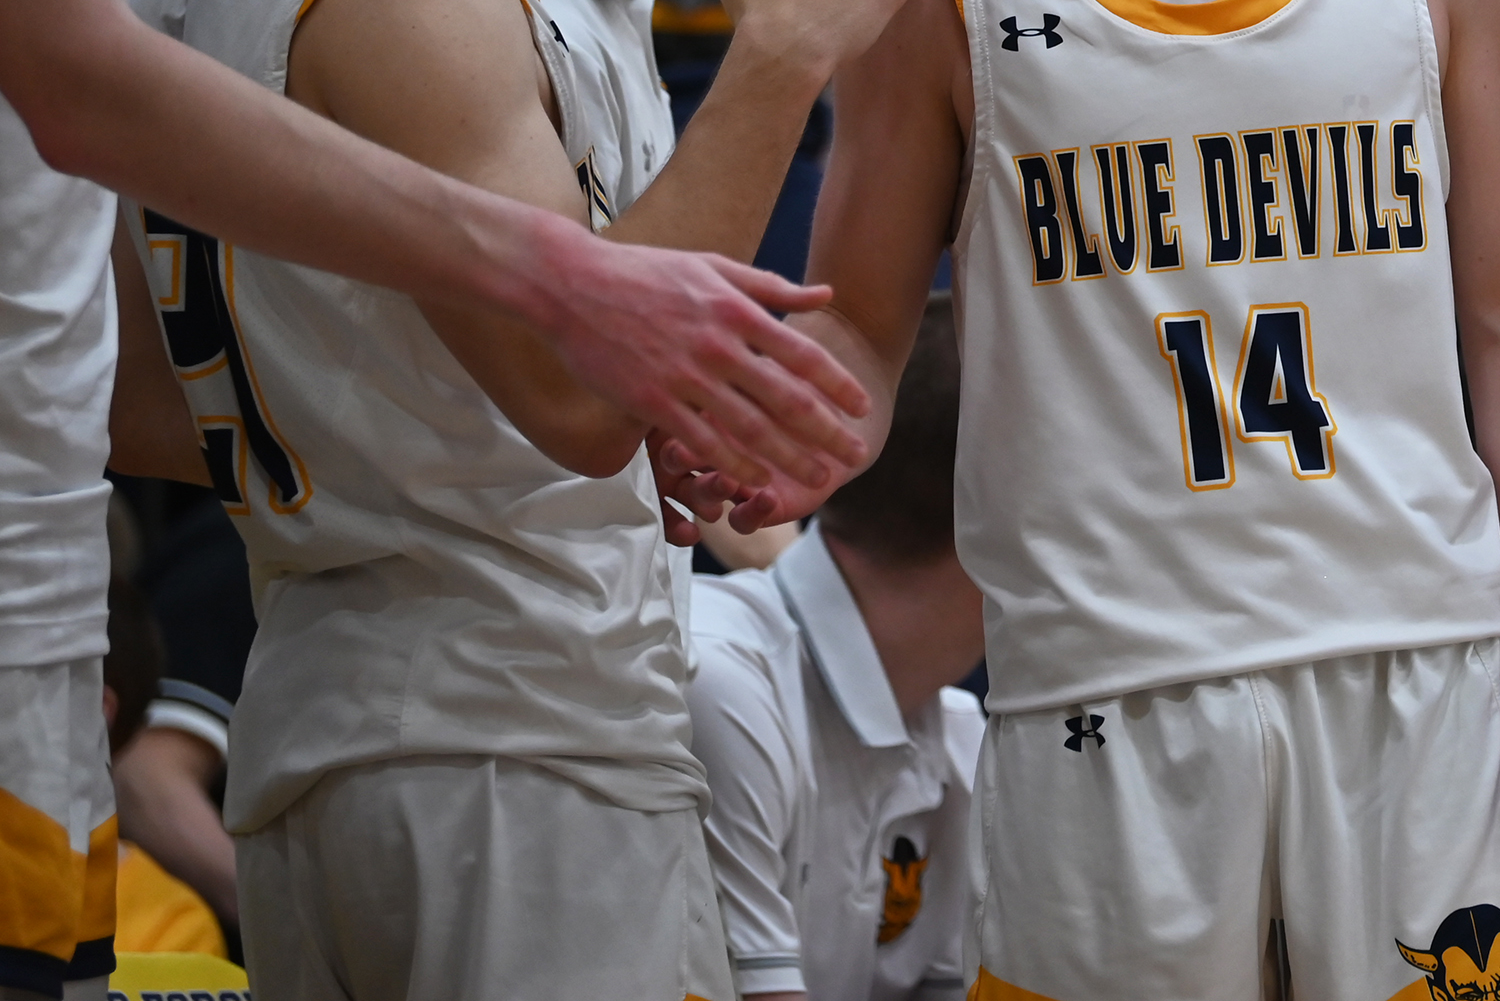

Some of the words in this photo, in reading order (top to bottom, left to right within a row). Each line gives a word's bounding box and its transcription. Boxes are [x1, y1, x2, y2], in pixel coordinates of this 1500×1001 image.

[1012, 138, 1185, 286] BLUE
[1193, 119, 1428, 267] DEVILS
[1154, 301, 1338, 493] 14
